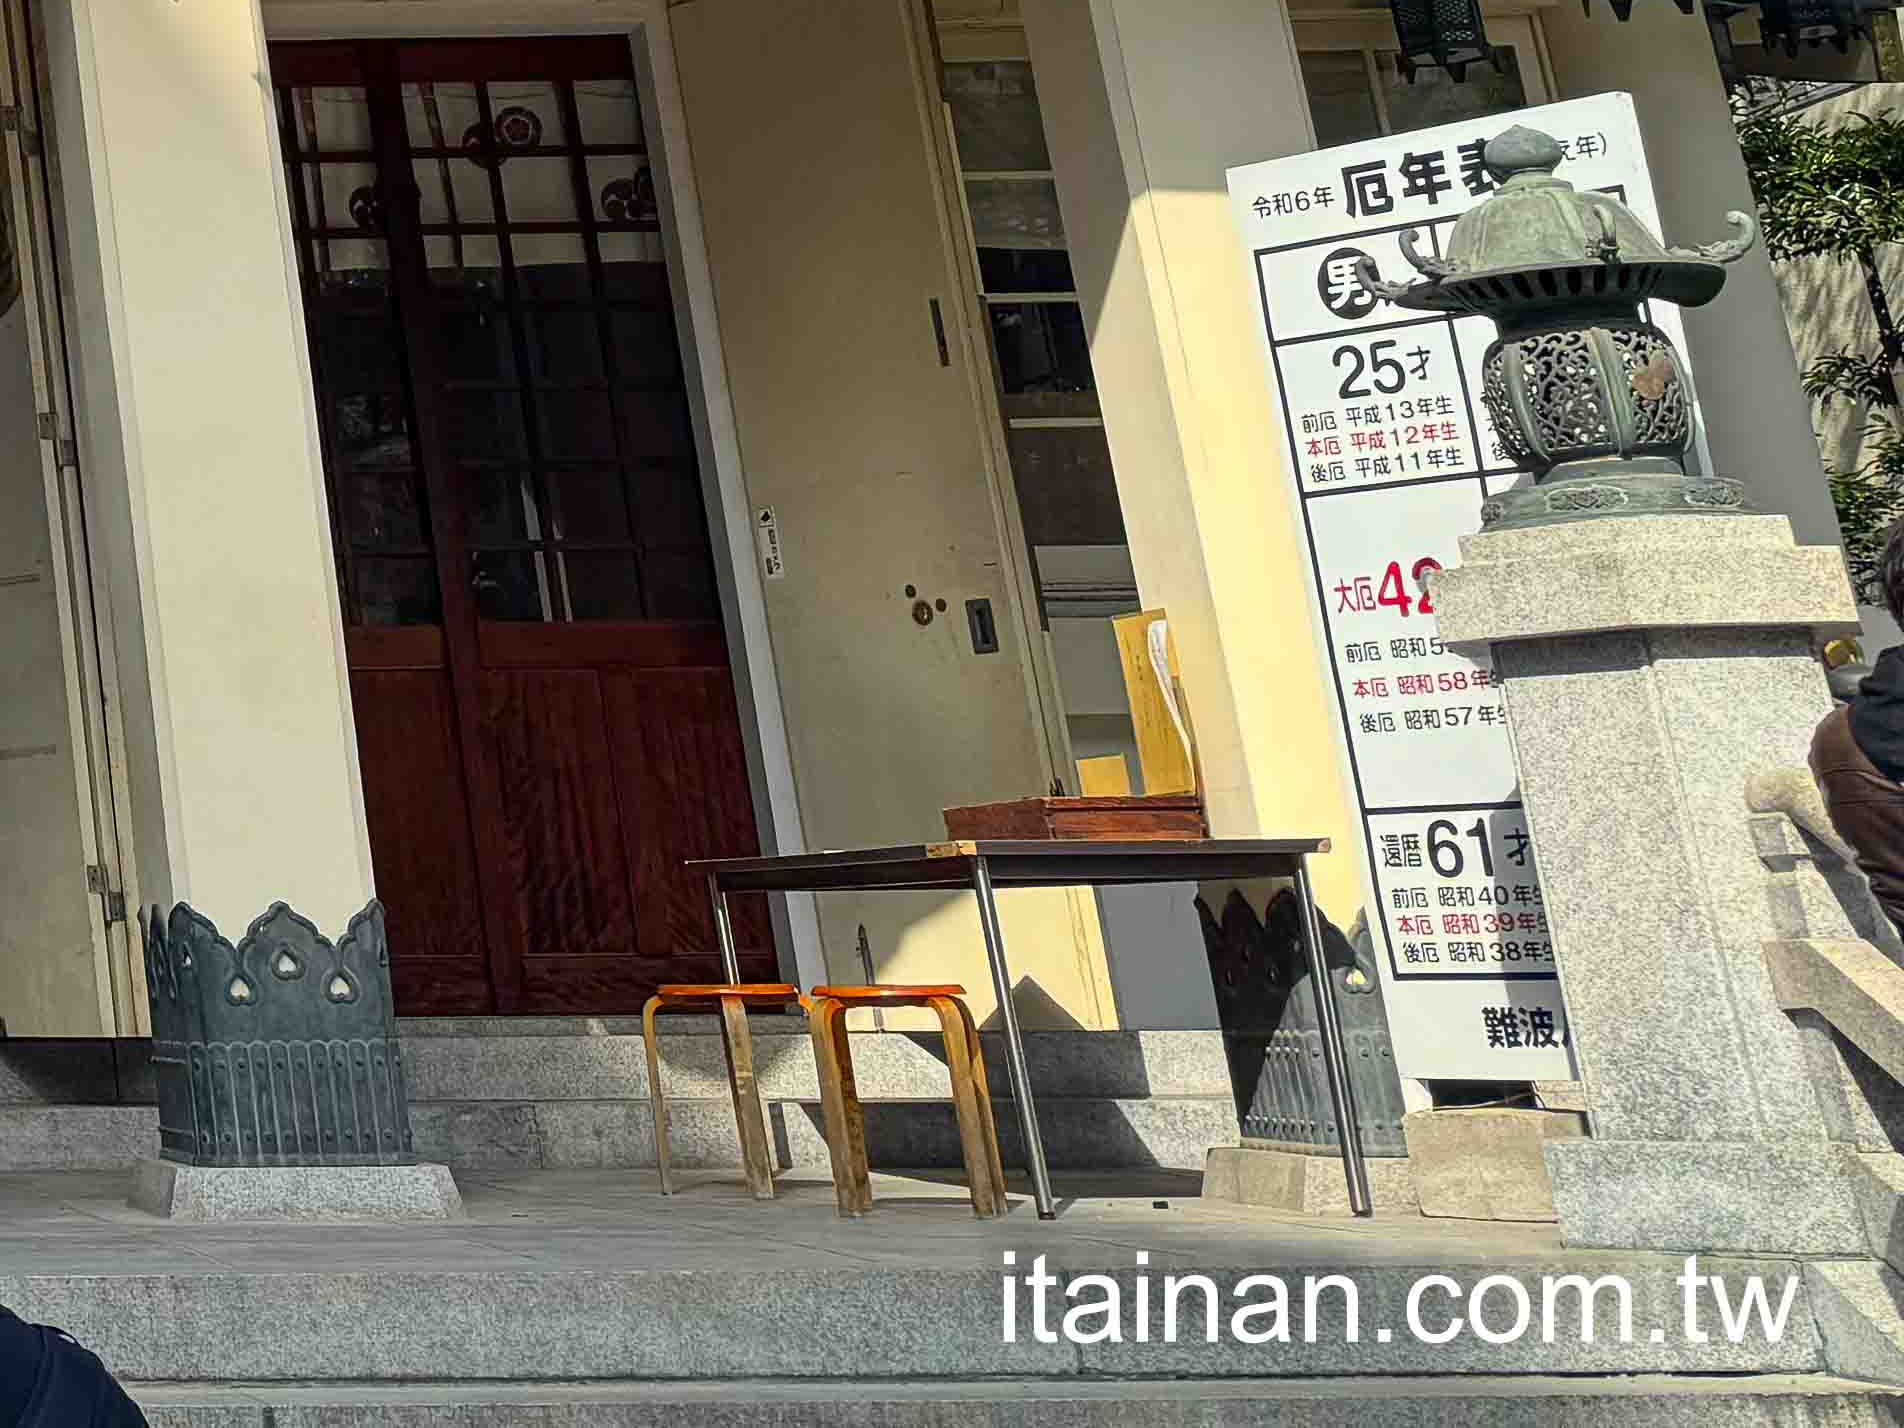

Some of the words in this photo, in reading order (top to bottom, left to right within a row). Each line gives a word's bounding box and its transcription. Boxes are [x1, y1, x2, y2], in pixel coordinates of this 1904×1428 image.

[1252, 185, 1336, 219] 令和6年
[1332, 339, 1431, 400] 25才
[1301, 410, 1338, 434] 前厄
[1345, 396, 1456, 428] 平成13年生
[1306, 435, 1342, 457] 本厄
[1350, 421, 1461, 450] 平成12年生
[1311, 461, 1347, 483] 後厄
[1355, 448, 1465, 478] 平成11年生
[1345, 640, 1382, 663] 前厄
[1390, 636, 1448, 659] 昭和5
[1353, 677, 1389, 698] 本厄
[1359, 711, 1396, 733] 後厄
[1392, 887, 1429, 909] 前厄
[1396, 914, 1434, 936] 本厄
[1403, 942, 1440, 963] 後厄
[1481, 1007, 1570, 1049] 難波
